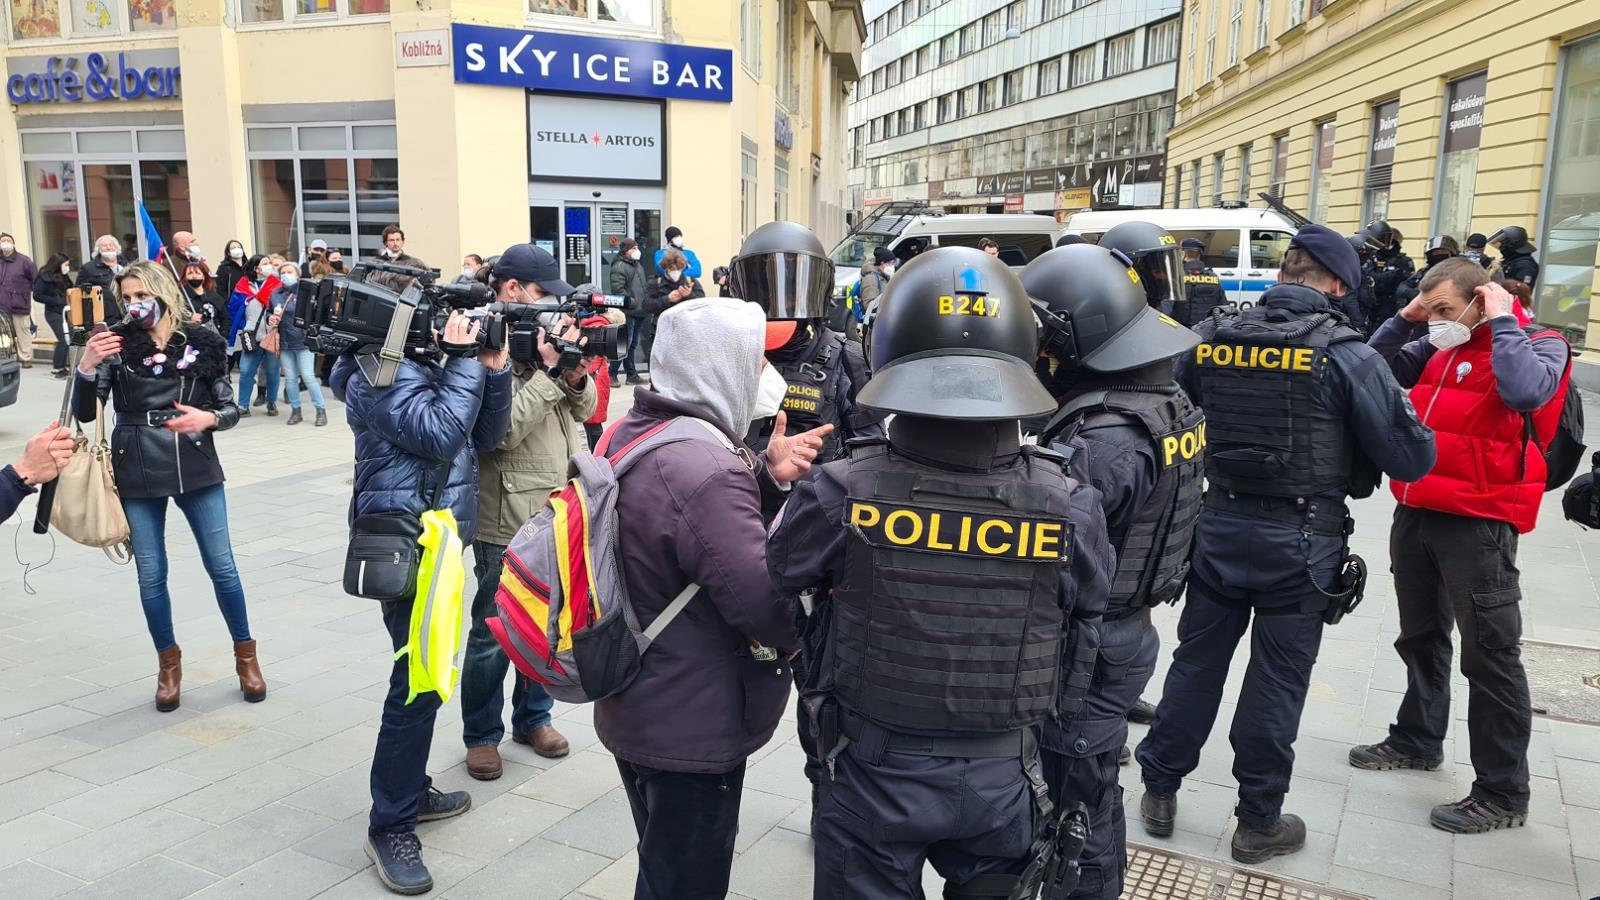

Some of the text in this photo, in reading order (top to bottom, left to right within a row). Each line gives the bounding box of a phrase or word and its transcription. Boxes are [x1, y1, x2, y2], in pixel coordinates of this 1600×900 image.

[402, 40, 443, 57] Kobližná
[465, 34, 723, 90] SKY ICE BAR
[537, 131, 655, 148] STELLA ARTOIS
[1183, 275, 1219, 285] POLICIE
[938, 295, 1000, 317] B247
[1196, 343, 1314, 372] POLICIE
[788, 385, 821, 397] OLICIE
[783, 398, 816, 411] 318100
[850, 502, 1064, 558] POLICIE
